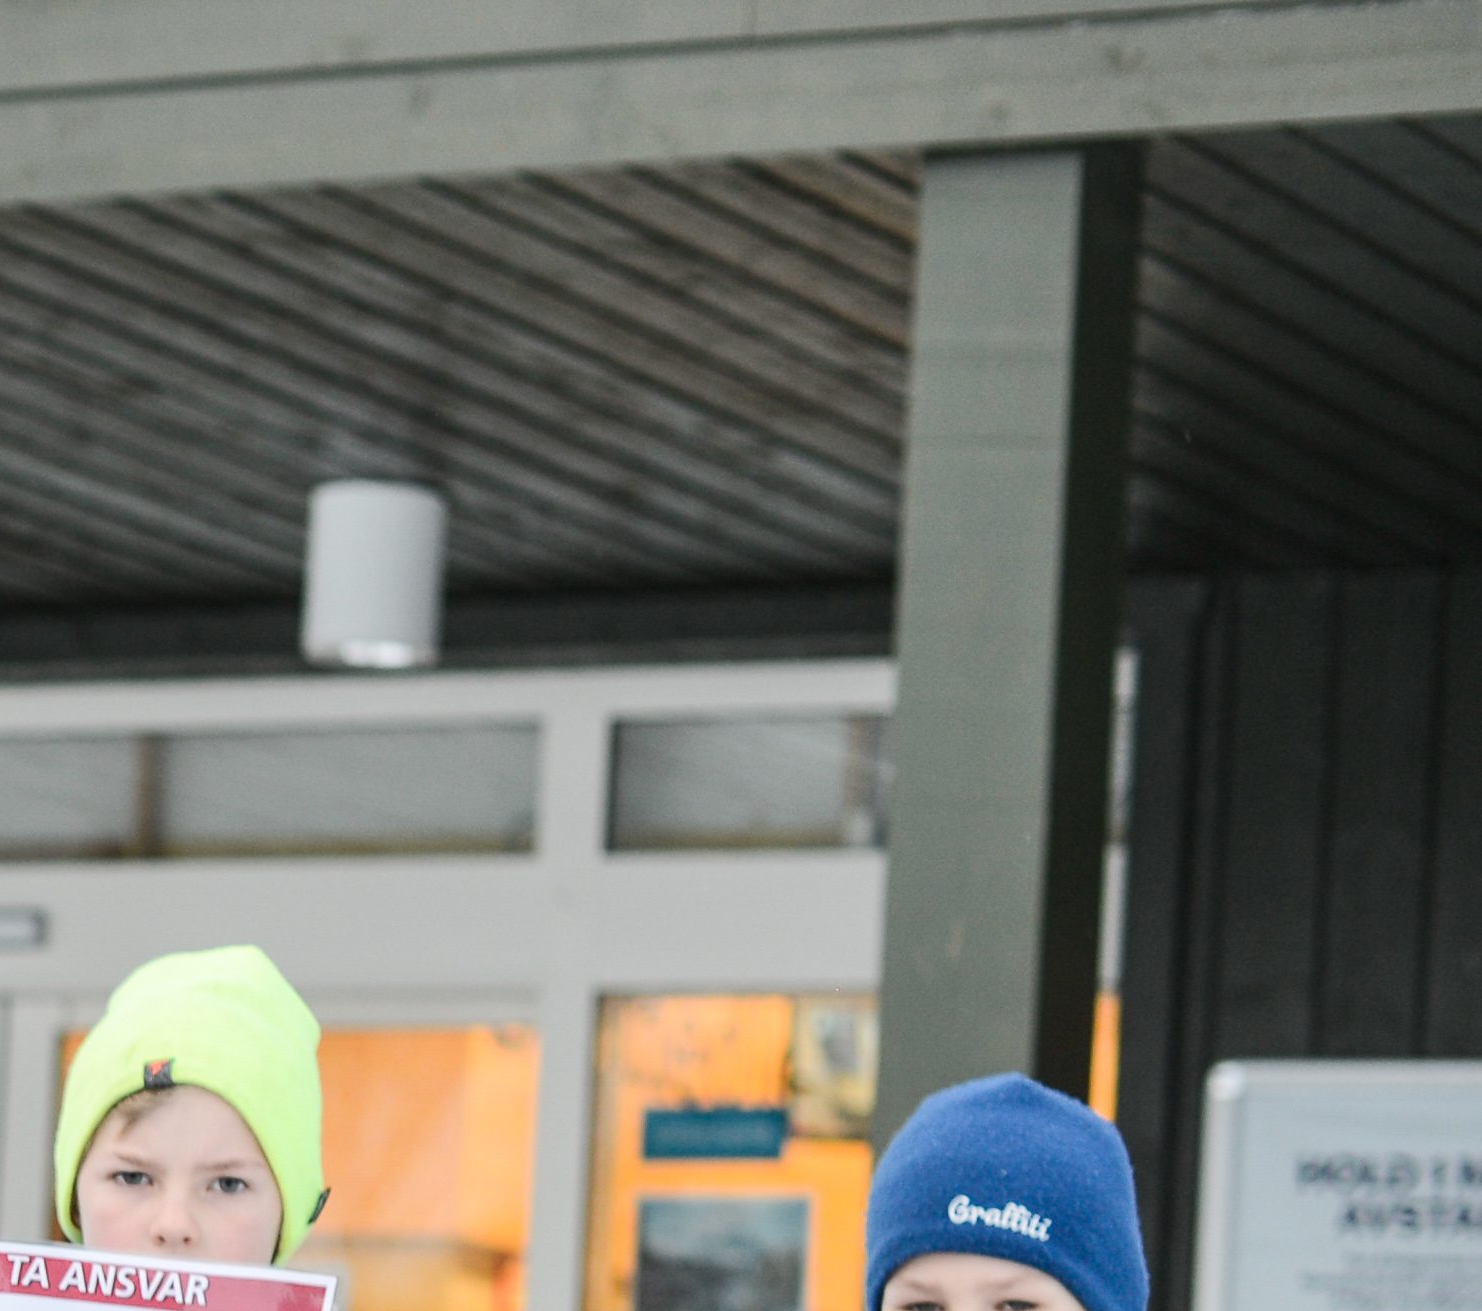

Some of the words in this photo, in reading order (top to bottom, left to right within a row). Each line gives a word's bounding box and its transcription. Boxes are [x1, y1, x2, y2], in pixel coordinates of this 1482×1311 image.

[948, 1194, 1052, 1242] Graffiti
[8, 1254, 49, 1289] TA
[59, 1261, 209, 1306] ANSVAR
